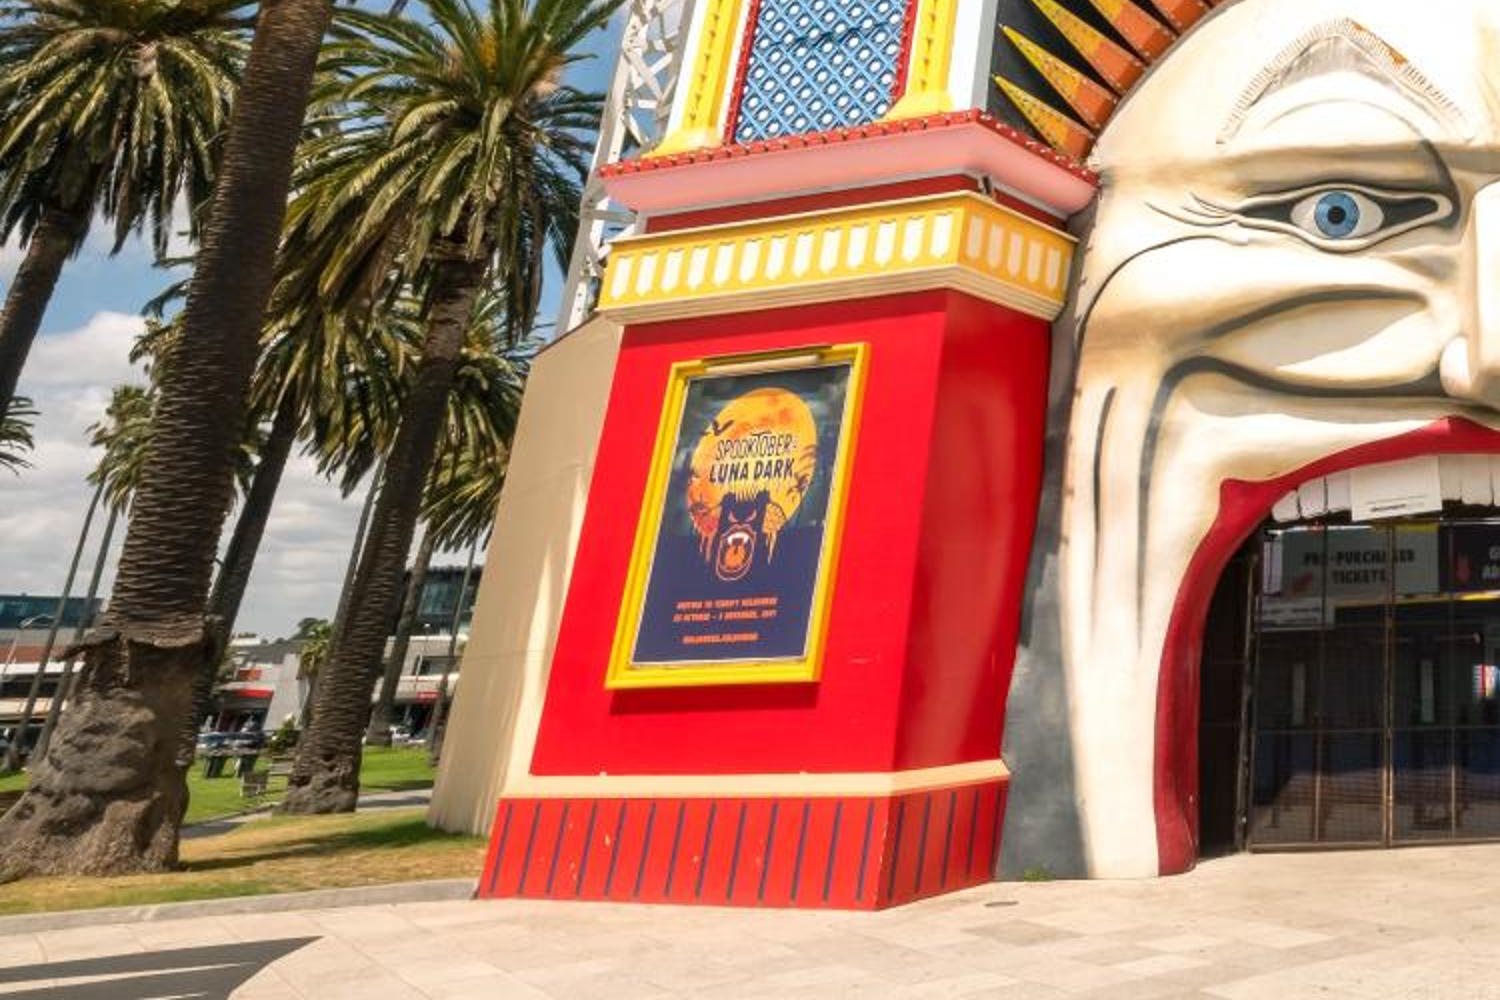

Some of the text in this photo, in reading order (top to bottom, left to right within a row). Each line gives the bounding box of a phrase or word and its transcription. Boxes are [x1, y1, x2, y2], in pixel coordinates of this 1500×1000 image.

[709, 457, 795, 483] LUNA DARK
[1302, 548, 1416, 567] PR-PURCHAED
